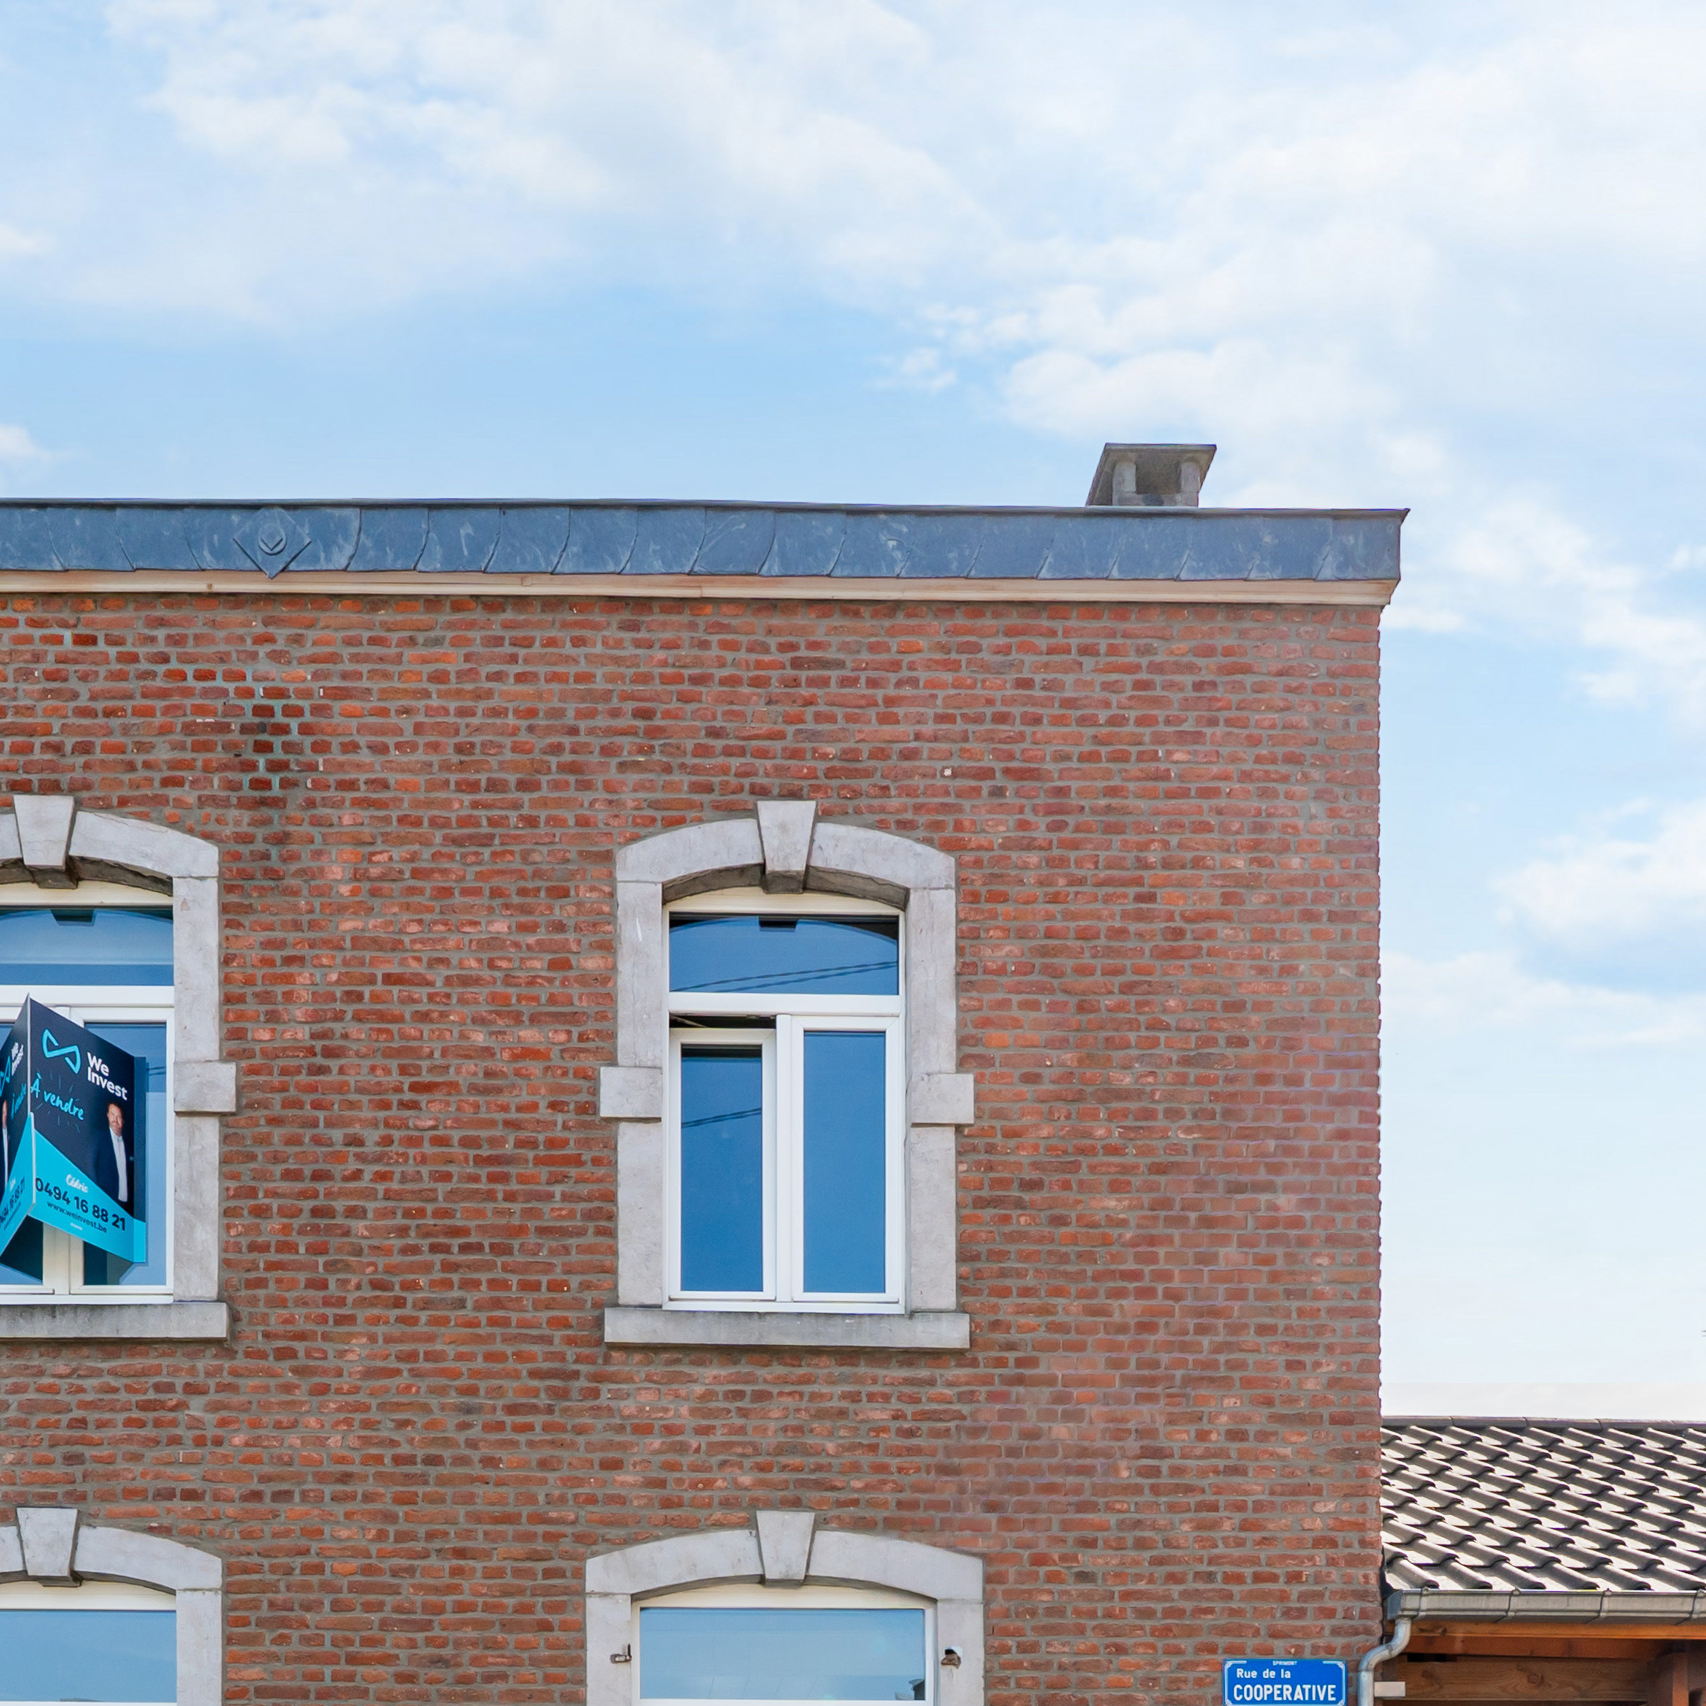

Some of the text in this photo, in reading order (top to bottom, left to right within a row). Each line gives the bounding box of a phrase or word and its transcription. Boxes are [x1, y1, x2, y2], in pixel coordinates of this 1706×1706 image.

[87, 1051, 109, 1077] We
[30, 1072, 41, 1099] À
[43, 1090, 84, 1121] vendre
[87, 1066, 128, 1101] Invest
[35, 1177, 71, 1206] 0494
[73, 1196, 89, 1214] 16
[92, 1204, 109, 1223] 88
[111, 1213, 126, 1232] 21
[46, 1200, 108, 1233] www.weinvest.be
[1236, 1668, 1291, 1679] Rue de la
[1233, 1684, 1337, 1701] COOPERATIVE
